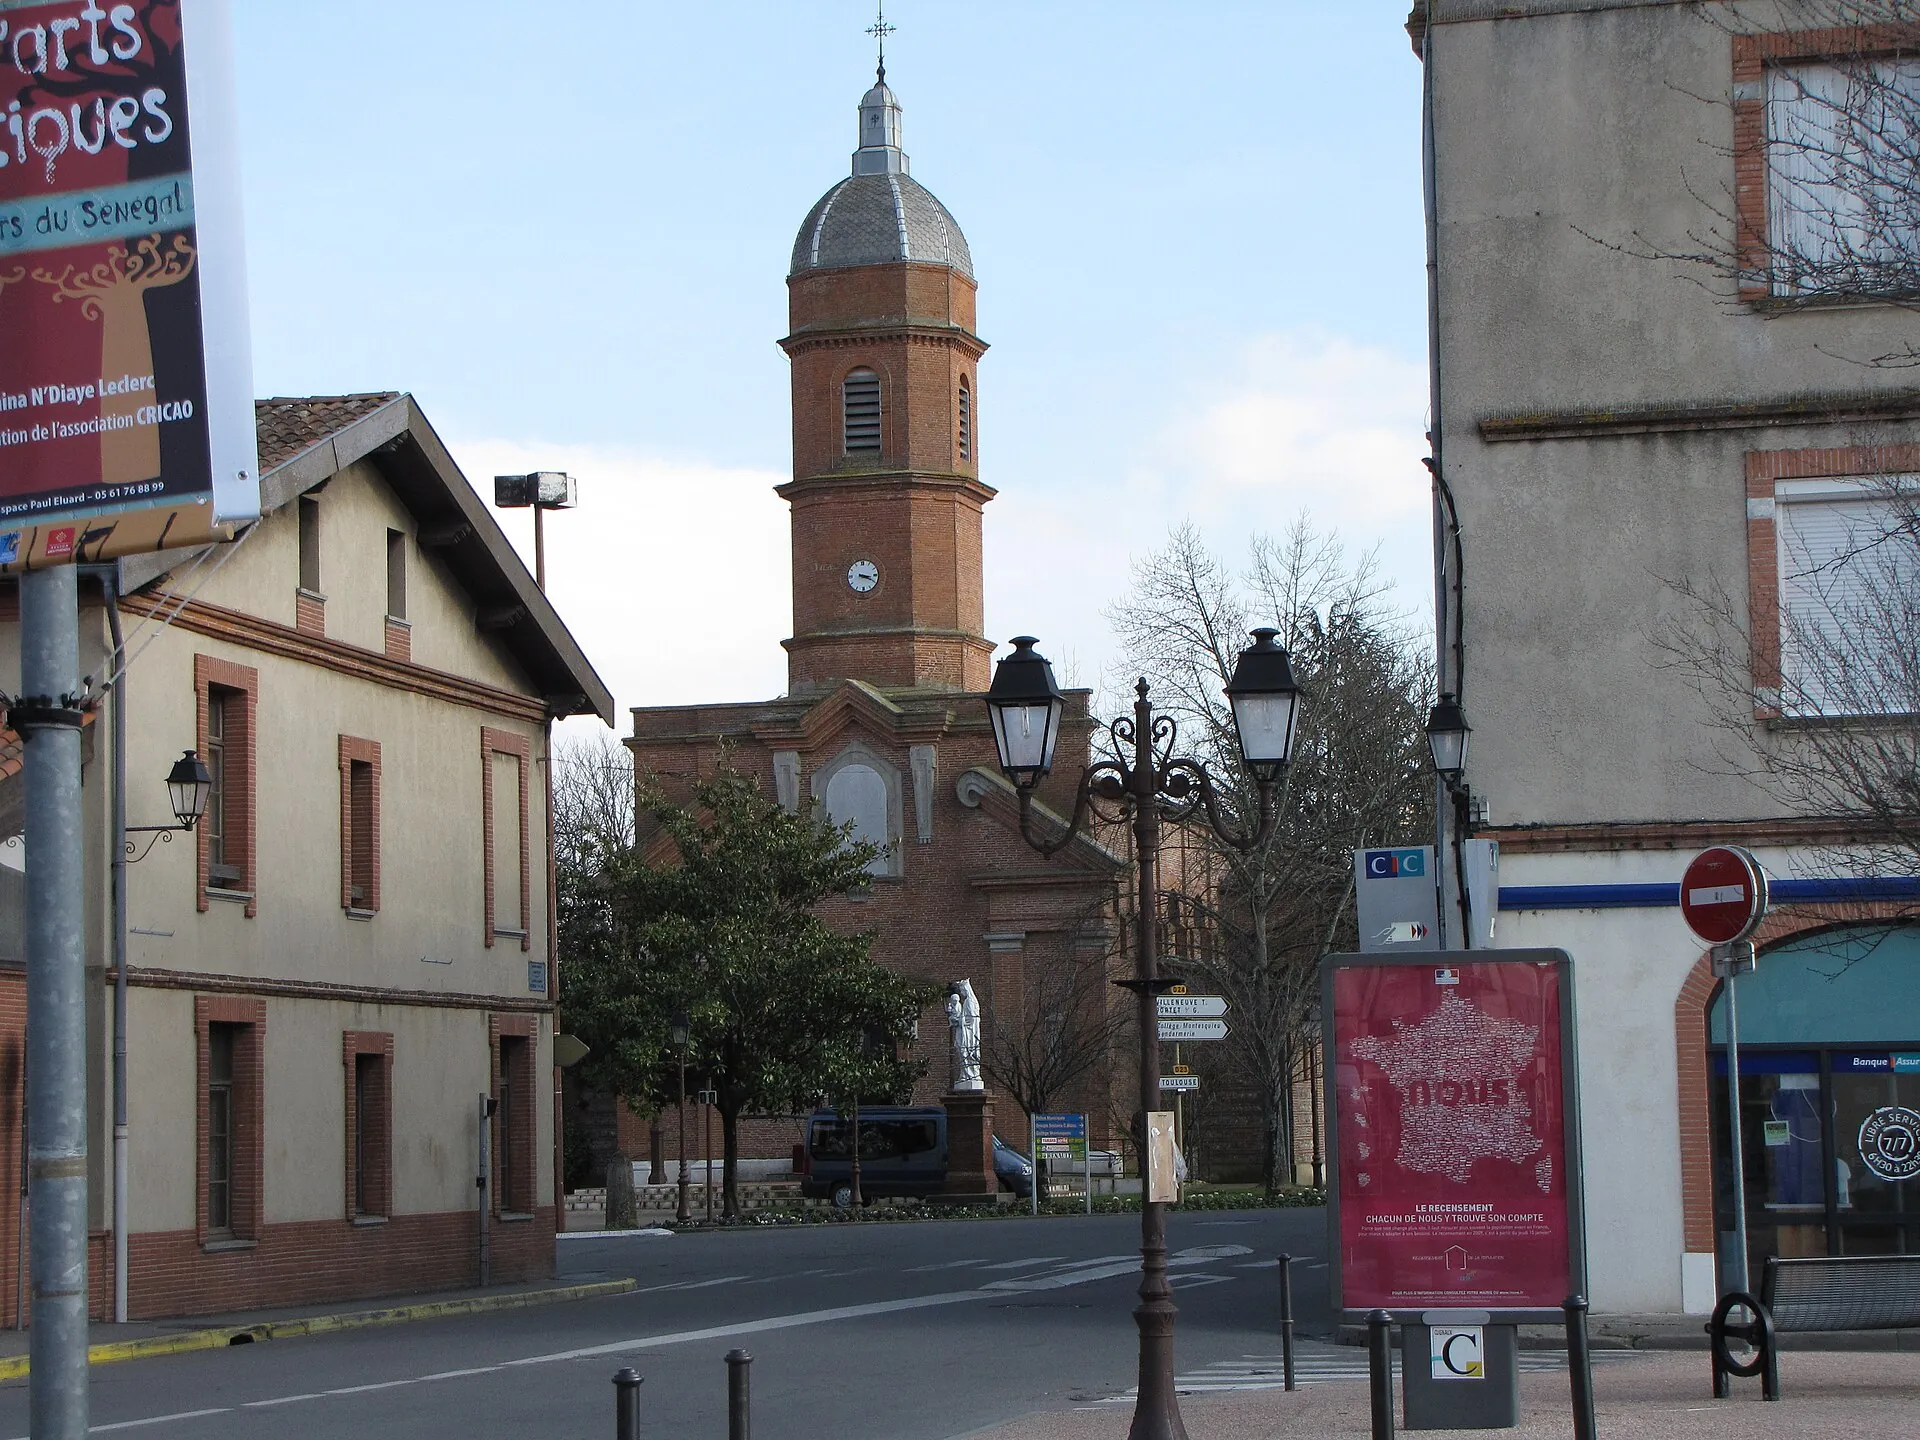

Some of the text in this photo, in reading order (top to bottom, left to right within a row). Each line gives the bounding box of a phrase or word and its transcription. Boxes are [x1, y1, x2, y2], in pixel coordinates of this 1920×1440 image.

[36, 206, 68, 235] du
[31, 384, 95, 406] N'Diaye
[98, 374, 156, 397] Leclerc
[0, 400, 194, 446] tion de l'association CRICAO
[1, 503, 29, 515] space
[30, 497, 52, 510] Paul
[53, 492, 86, 506] Eluard
[95, 491, 107, 500] 05
[109, 488, 121, 498] 61
[123, 486, 136, 496] 76
[138, 484, 150, 494] 88
[152, 481, 165, 492] 99
[1371, 855, 1418, 874] CIC
[1853, 1057, 1888, 1068] Banque
[1865, 1117, 1886, 1143] LIBRE
[1883, 1137, 1907, 1152] 7/7
[1894, 1164, 1900, 1173] à
[1365, 1213, 1544, 1223] CHACUN DE NOUS Y TROUVE SON COMPTE
[1415, 1203, 1494, 1213] LE RECENSEMENT
[1442, 1333, 1478, 1376] C
